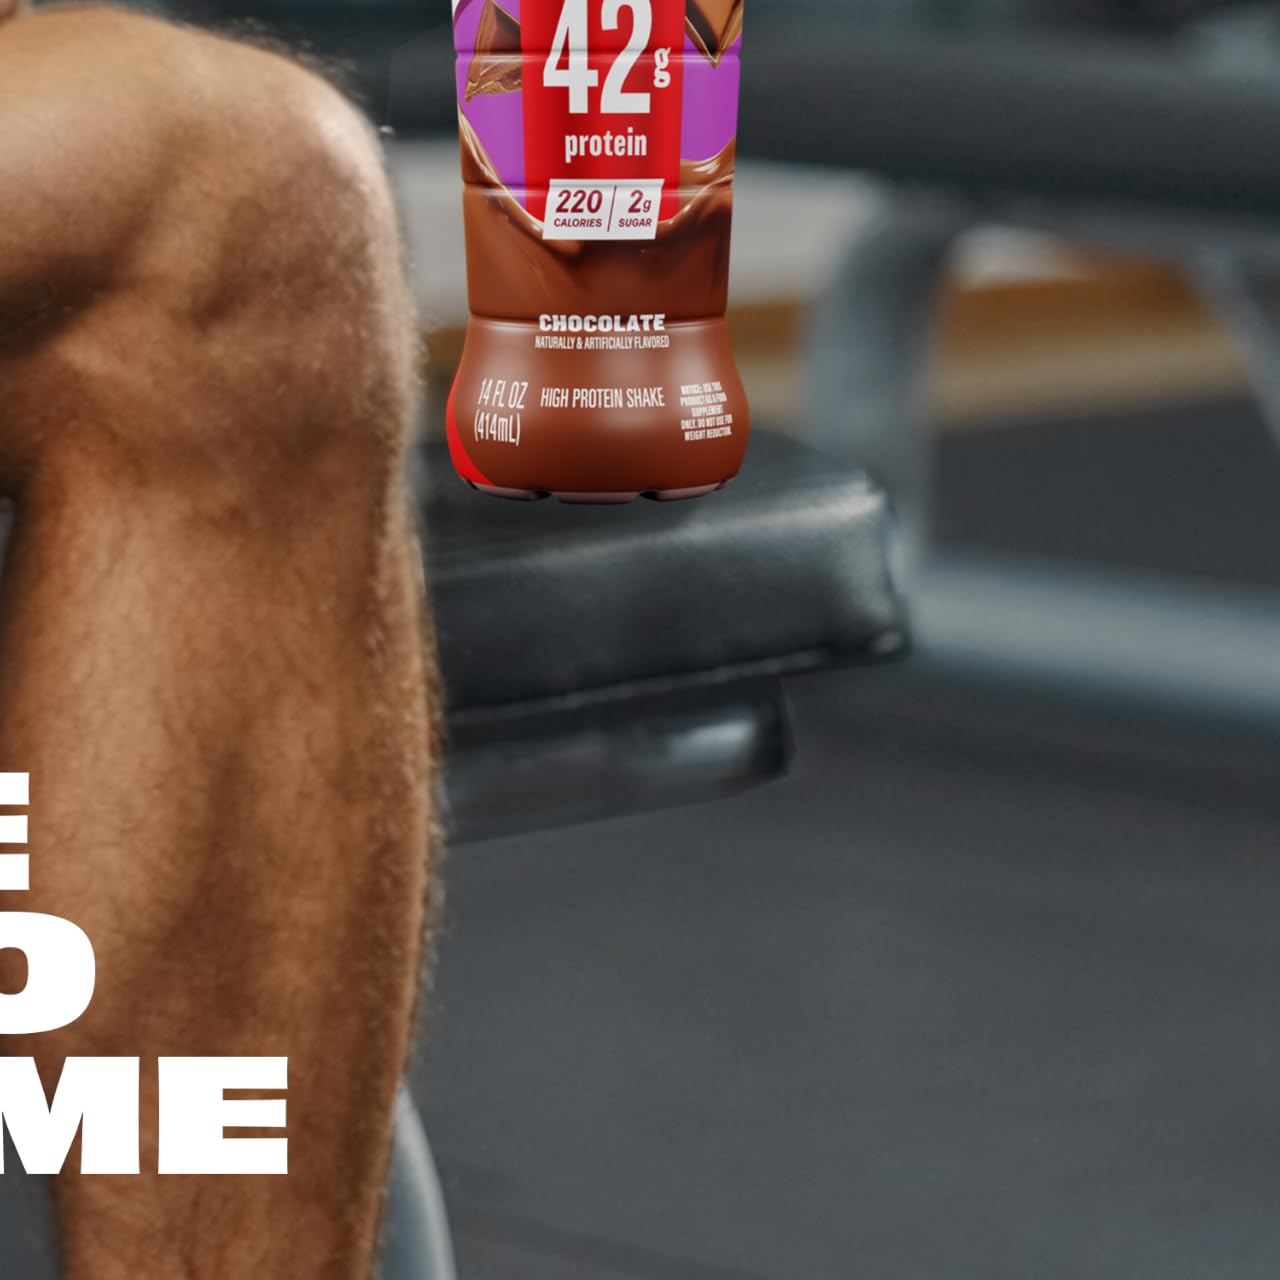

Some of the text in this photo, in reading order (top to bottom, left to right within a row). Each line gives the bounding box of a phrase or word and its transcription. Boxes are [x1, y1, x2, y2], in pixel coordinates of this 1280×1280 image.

[565, 126, 647, 164] protein
[556, 189, 603, 213] 220
[628, 189, 651, 213] 2g
[554, 218, 602, 228] CALORIES
[618, 218, 652, 227] SUGAR
[539, 314, 666, 332] CHOCOLATE
[535, 335, 670, 350] NATURALLY & ARTIFICIALLY FLAVORED
[478, 378, 529, 409] 14 FL OZ
[540, 387, 666, 408] HIGH PROTEIN SHAKE
[474, 408, 520, 447] (414mL)
